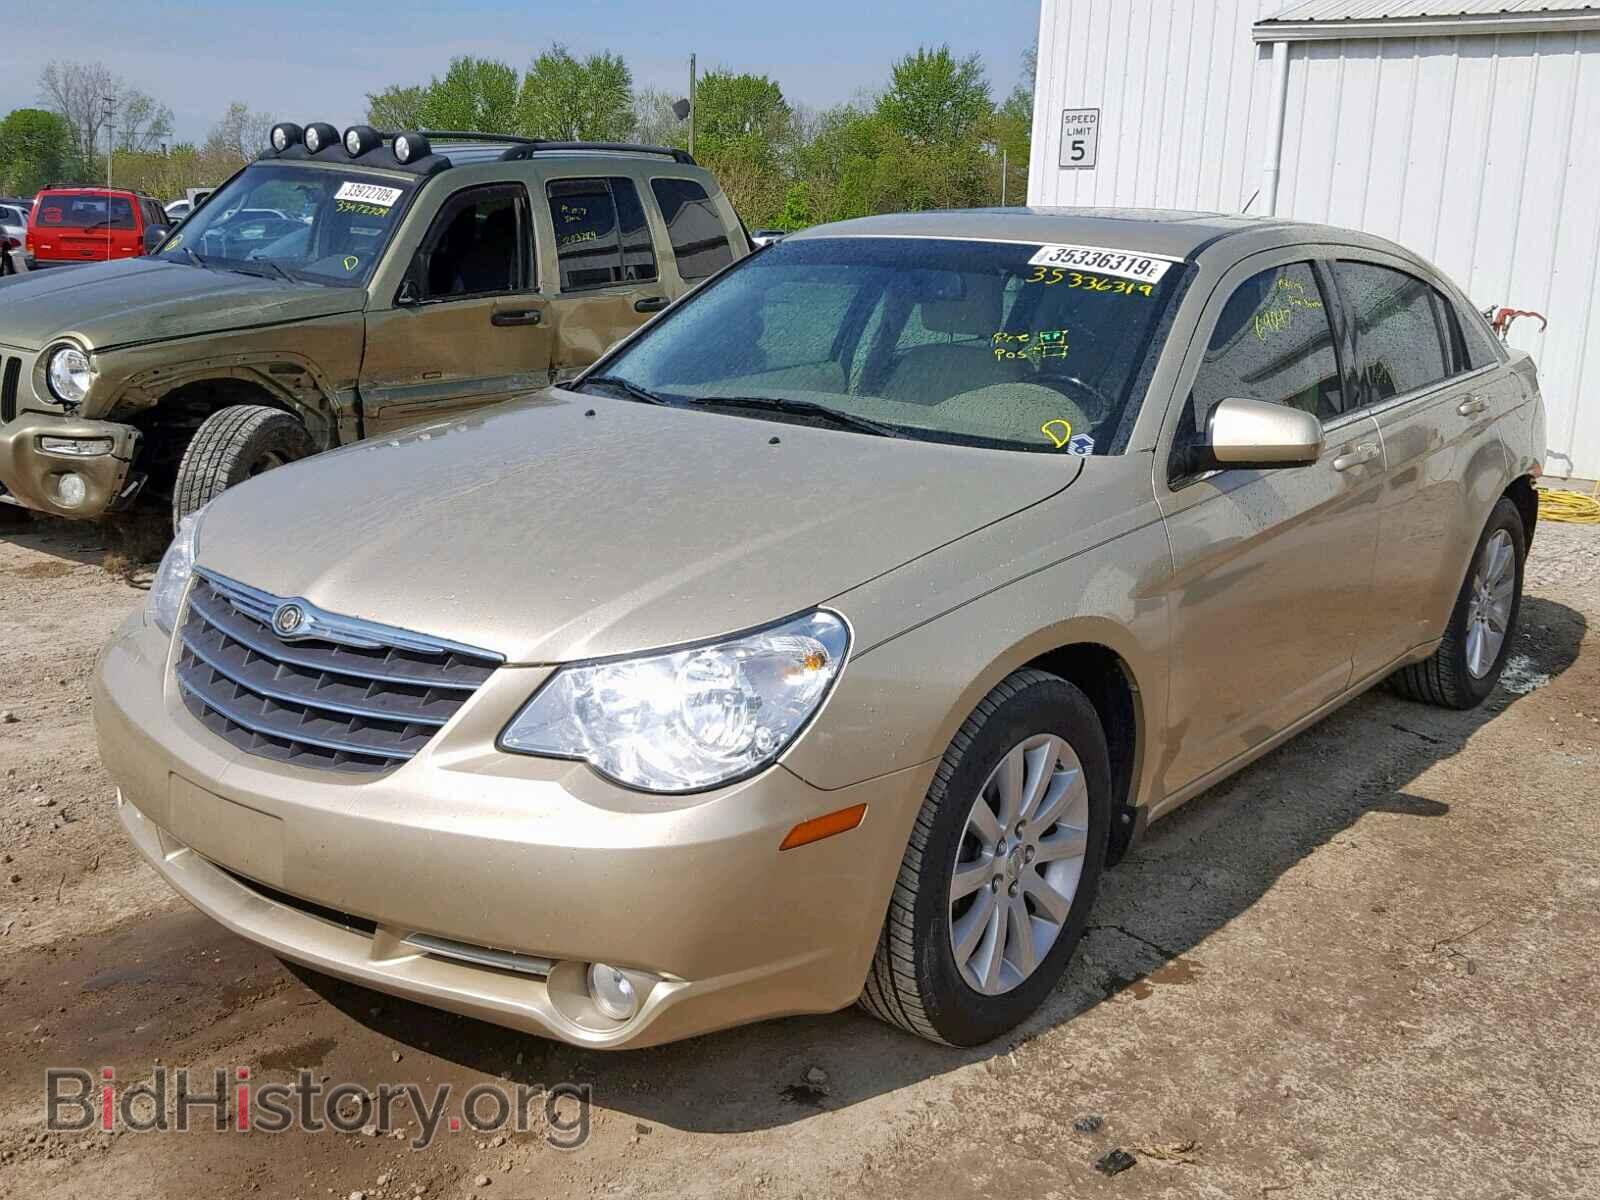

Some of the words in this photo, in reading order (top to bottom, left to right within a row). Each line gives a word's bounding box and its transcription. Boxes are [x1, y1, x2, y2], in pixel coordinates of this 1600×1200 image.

[1065, 114, 1096, 124] SPEED
[1066, 127, 1091, 137] LIMIT
[1070, 140, 1085, 161] 5
[1049, 248, 1151, 276] 35336319
[1025, 266, 1154, 297] 35336319
[1041, 419, 1072, 448] D
